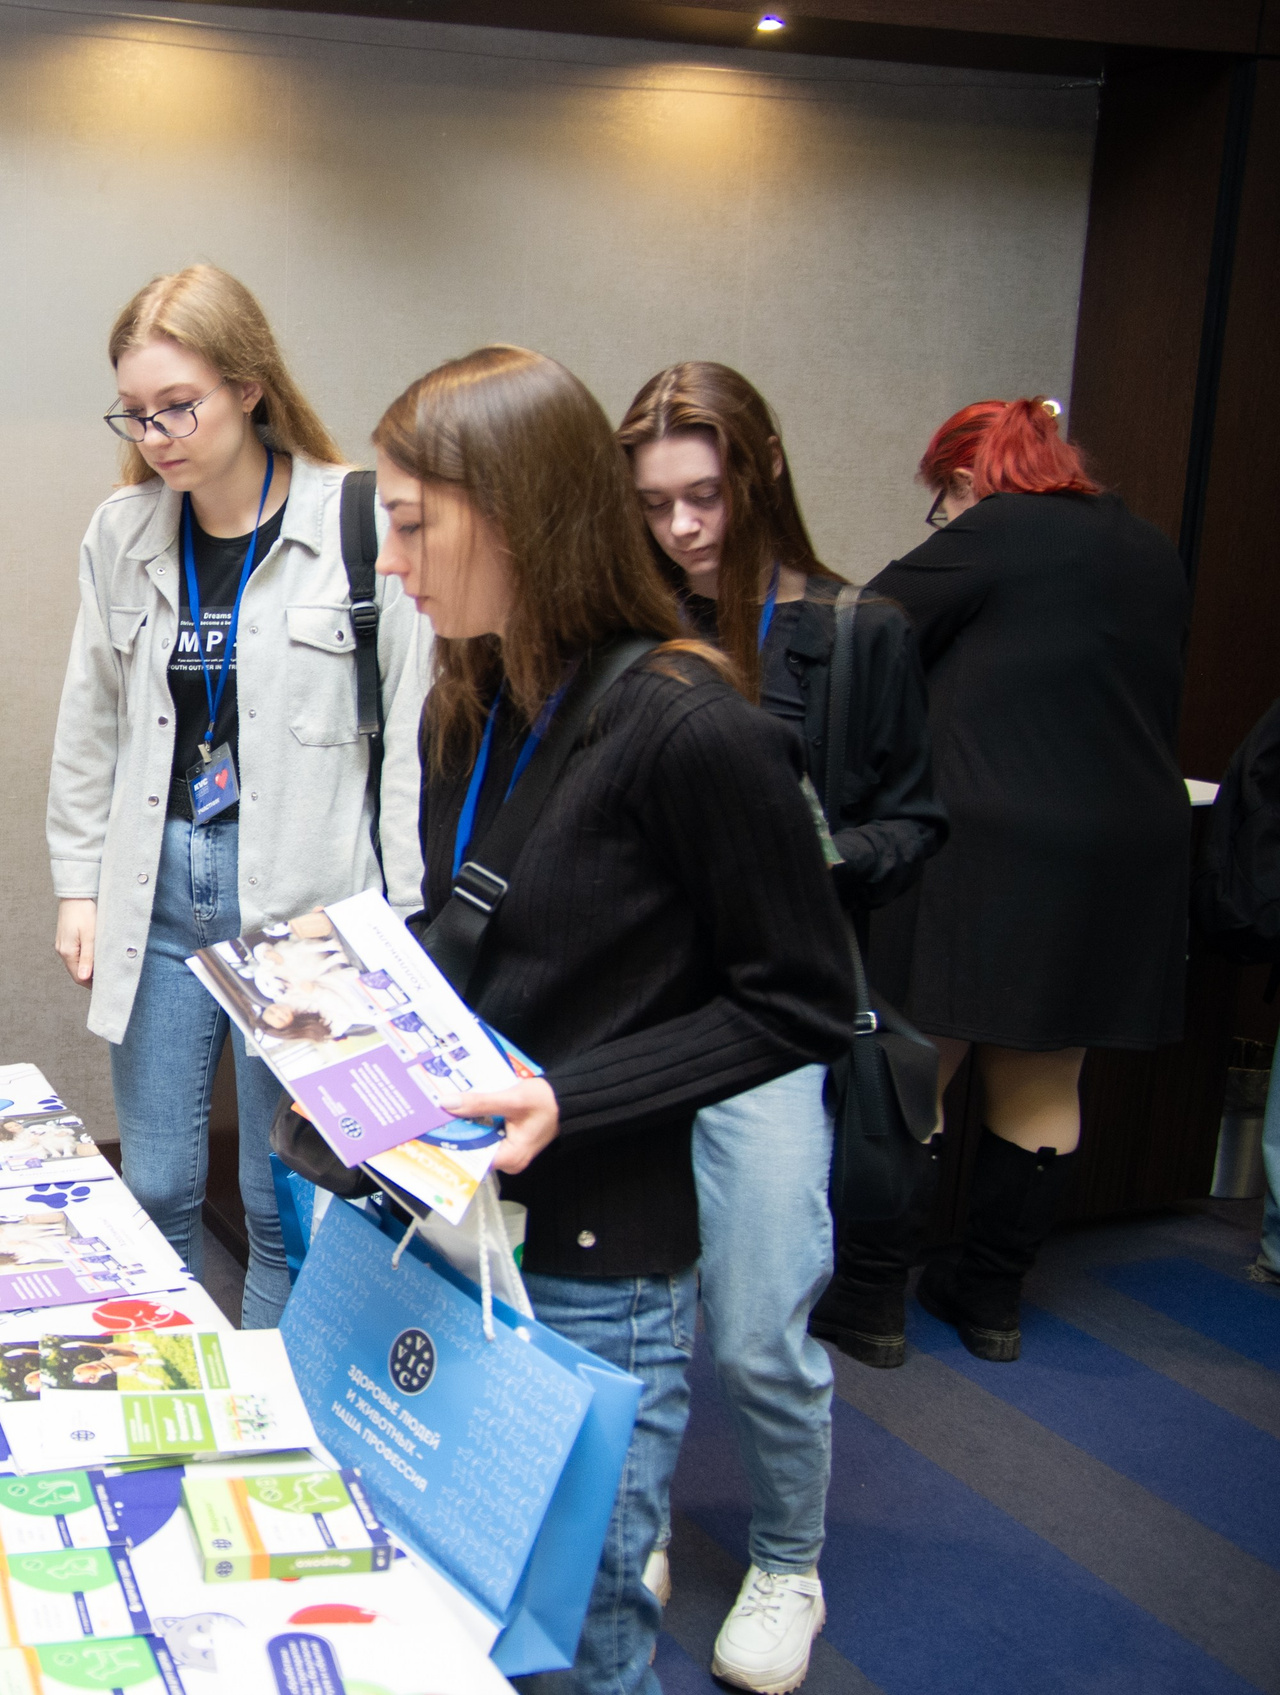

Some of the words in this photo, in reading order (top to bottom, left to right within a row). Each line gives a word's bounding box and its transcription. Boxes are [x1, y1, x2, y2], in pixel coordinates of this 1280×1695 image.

[329, 1400, 364, 1434] НАША
[360, 1428, 429, 1492] ПРОФЕССИЯ
[344, 1388, 357, 1402] И
[354, 1396, 417, 1456] ЖИВОТНЫХ
[346, 1363, 402, 1415] ЗДОРОВЬЕ
[397, 1409, 440, 1451] ЛЮДЕЙ
